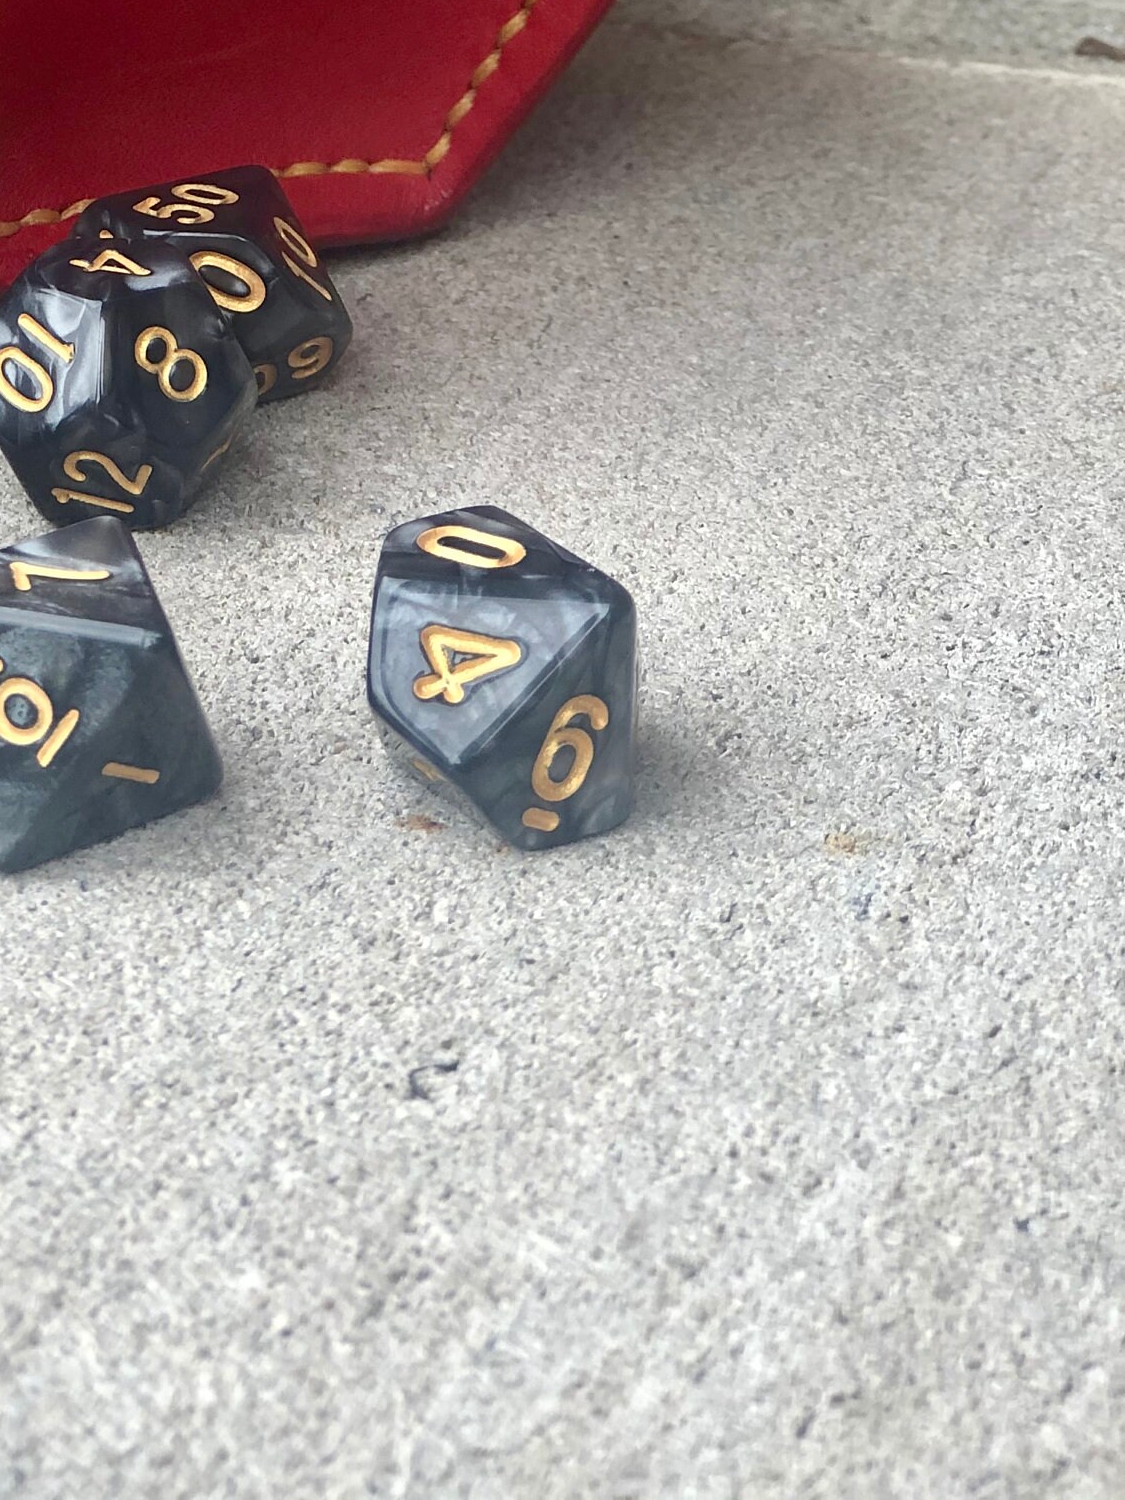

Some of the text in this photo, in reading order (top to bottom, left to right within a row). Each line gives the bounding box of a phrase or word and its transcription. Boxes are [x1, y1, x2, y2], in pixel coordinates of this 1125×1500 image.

[132, 183, 239, 224] 50
[69, 249, 151, 277] 4
[135, 326, 207, 401] 8
[51, 451, 152, 513] 12
[416, 525, 526, 569] 0
[413, 624, 521, 704] 4
